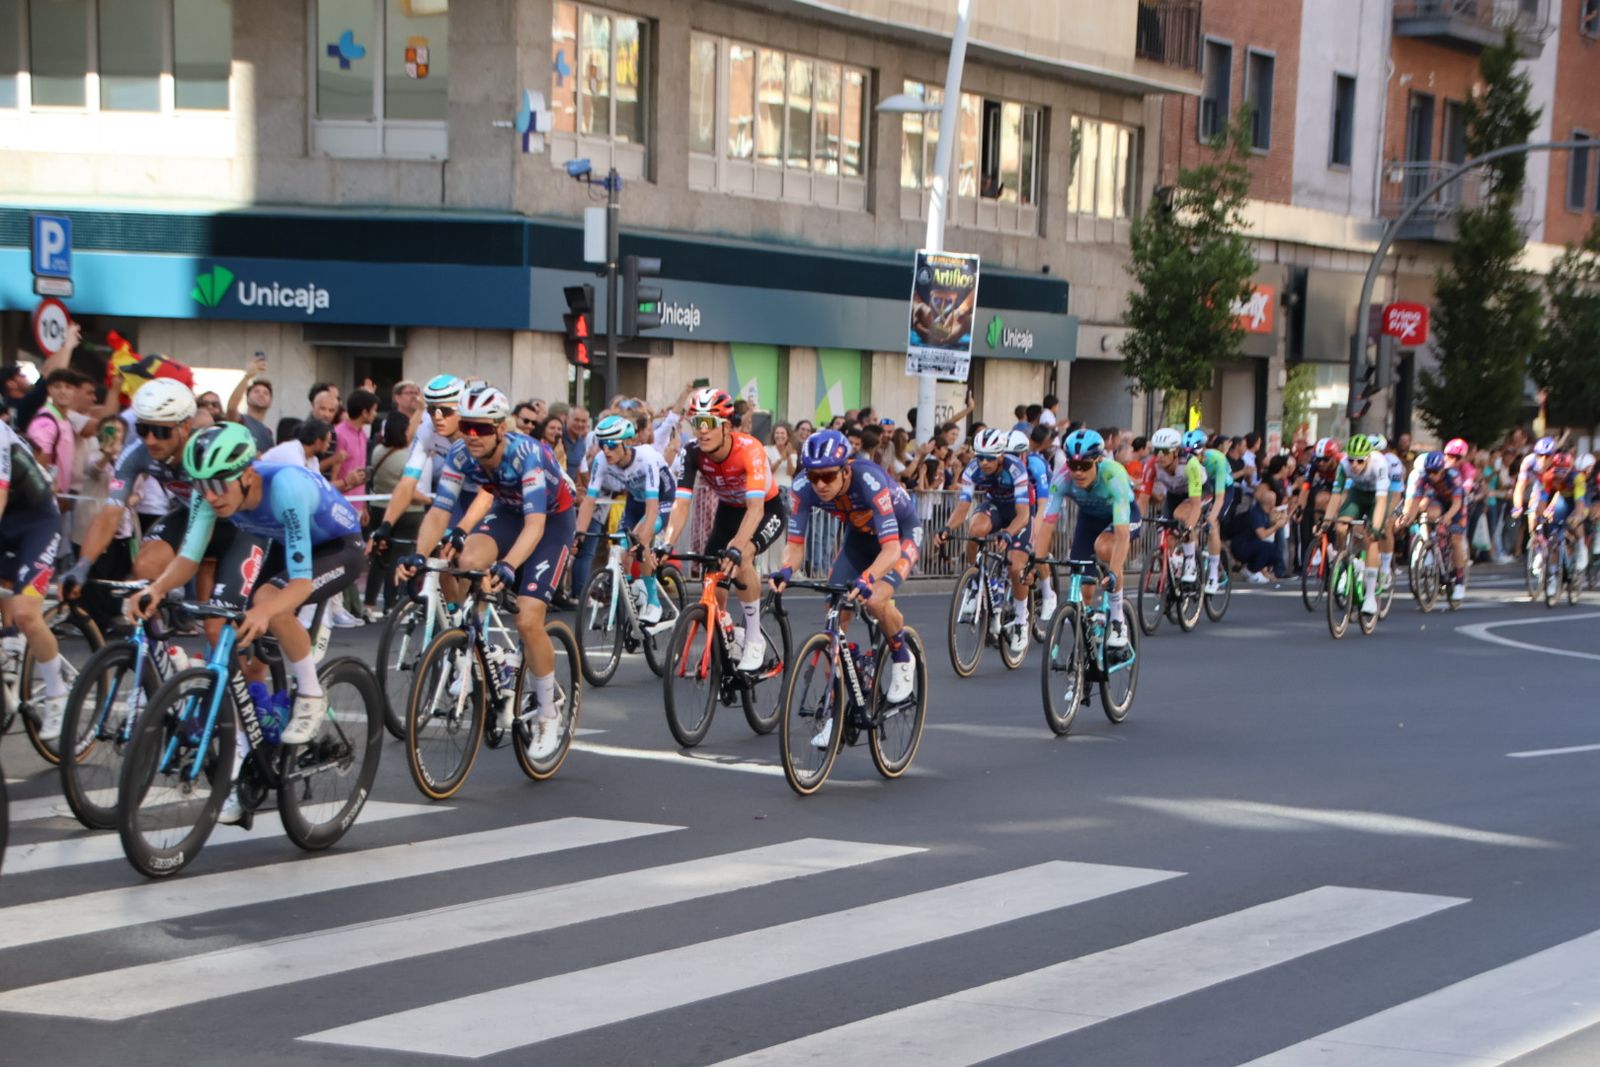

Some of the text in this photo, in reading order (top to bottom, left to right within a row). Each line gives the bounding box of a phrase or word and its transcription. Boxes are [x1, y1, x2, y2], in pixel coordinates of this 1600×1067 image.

[238, 281, 330, 315] Unicaja
[1003, 327, 1033, 354] Unicaja
[760, 514, 782, 544] INEOS
[840, 630, 866, 707] LAPIERRE
[231, 669, 265, 750] VAN RYSEL
